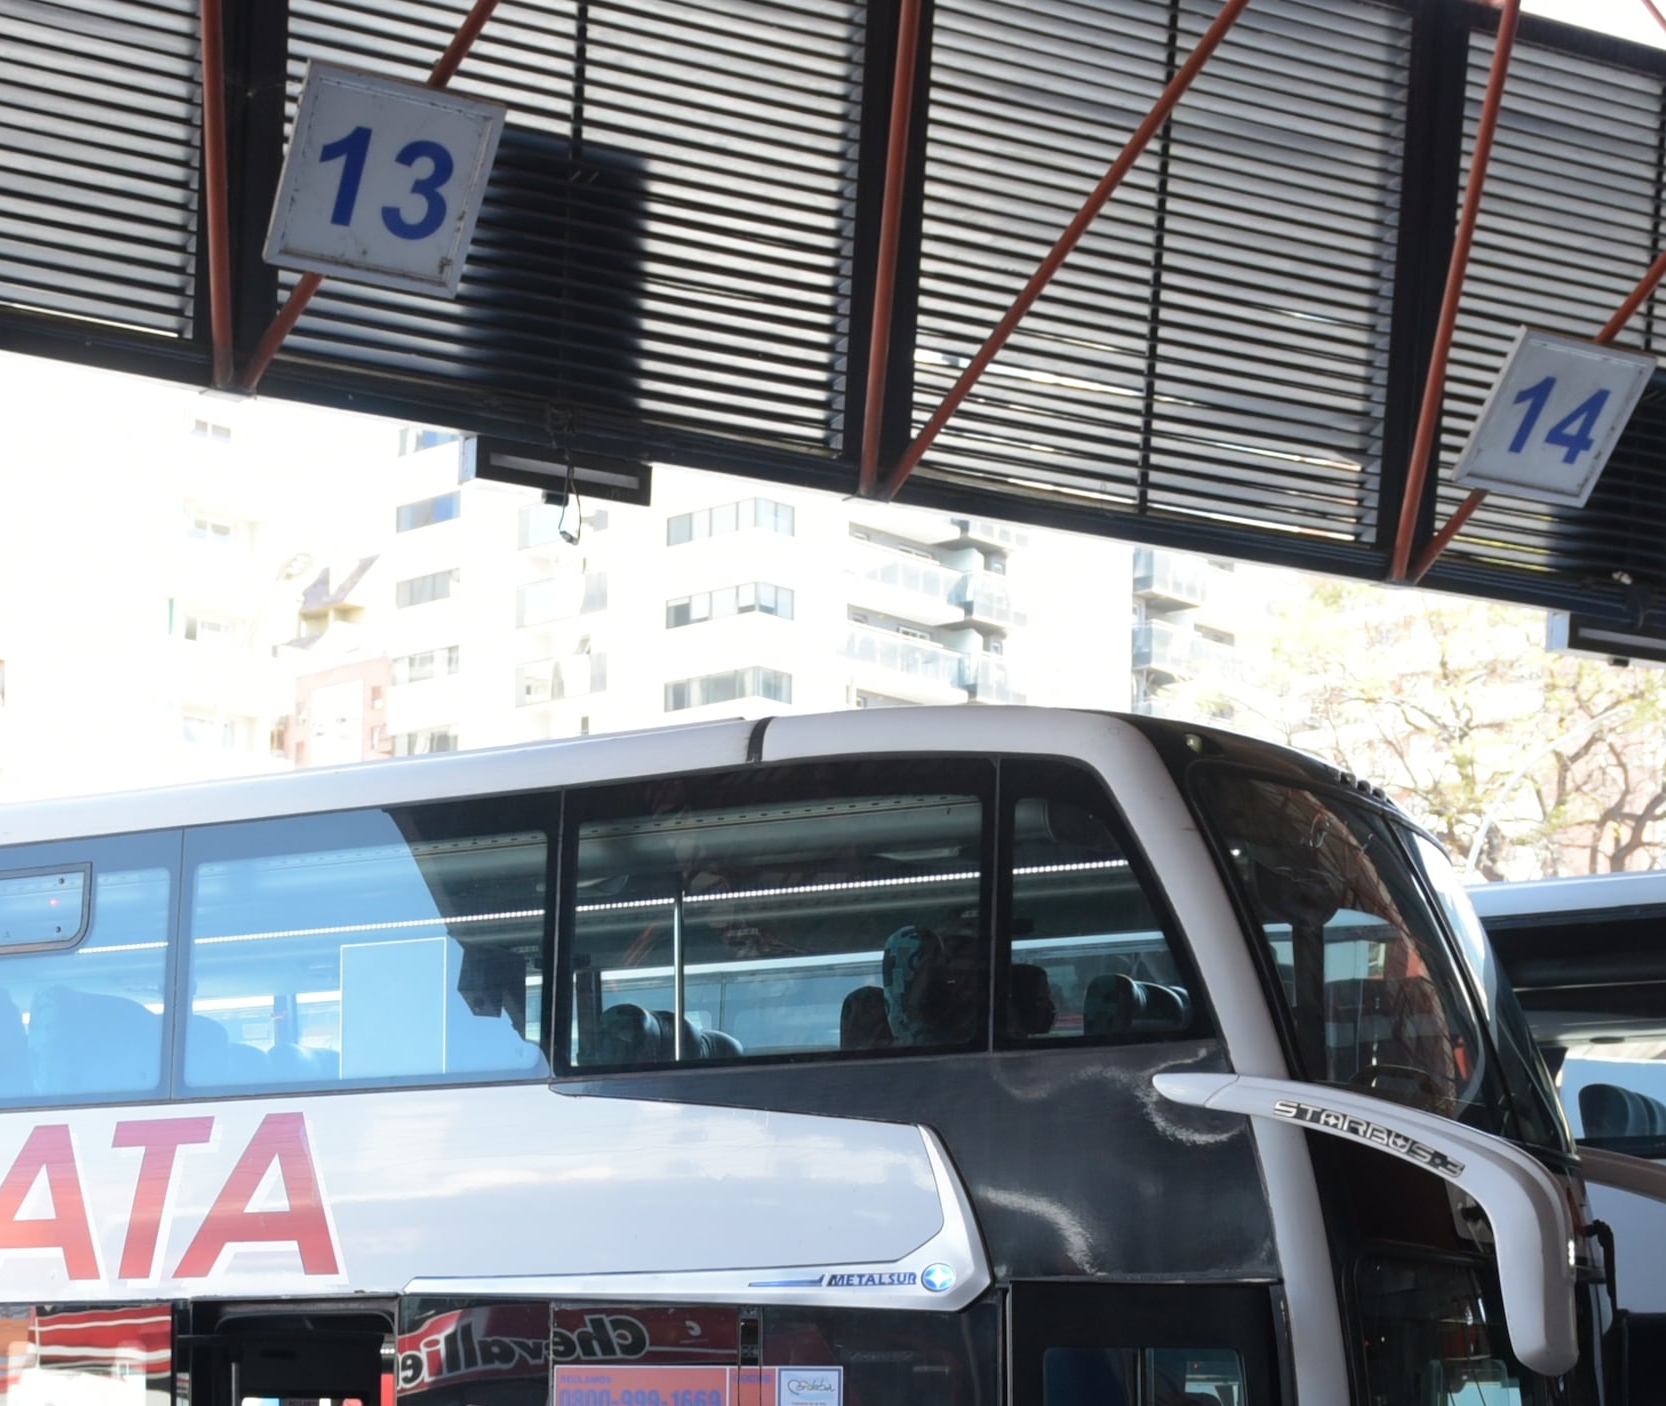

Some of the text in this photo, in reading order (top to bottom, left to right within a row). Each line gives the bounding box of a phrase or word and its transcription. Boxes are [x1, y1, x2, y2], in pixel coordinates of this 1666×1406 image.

[318, 125, 454, 241] 13
[1507, 375, 1612, 465] 14
[828, 1272, 917, 1288] METALSUR
